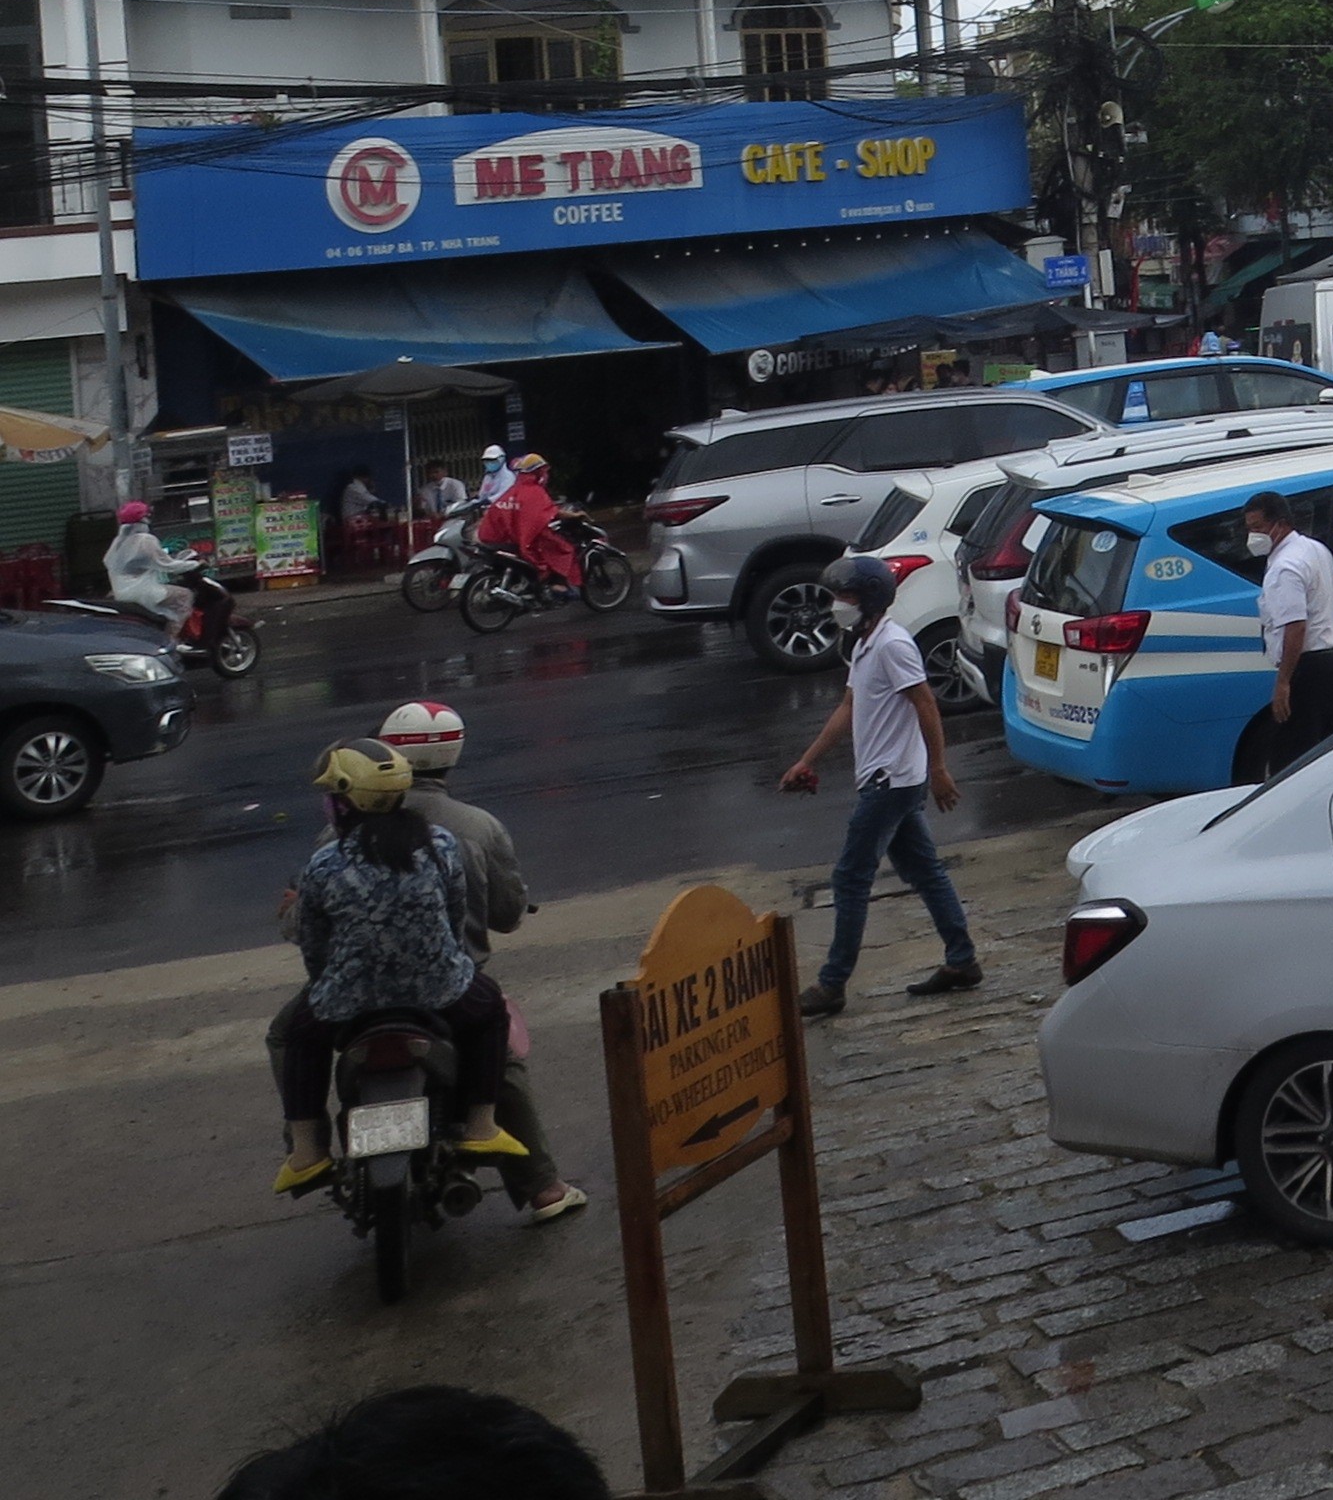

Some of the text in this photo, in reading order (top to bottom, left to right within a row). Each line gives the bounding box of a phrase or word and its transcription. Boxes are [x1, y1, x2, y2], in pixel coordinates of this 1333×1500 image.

[856, 136, 936, 178] SHOP
[473, 143, 694, 199] ME TRANG
[553, 202, 624, 226] COFFEE
[466, 235, 500, 247] TRANG
[776, 350, 833, 376] COFFEE
[234, 455, 268, 466] 10K
[1153, 559, 1186, 579] 838
[672, 971, 702, 1038] XE
[704, 964, 720, 1021] 2
[722, 937, 777, 1012] BÁNH
[668, 1014, 752, 1081] PARKING FOR
